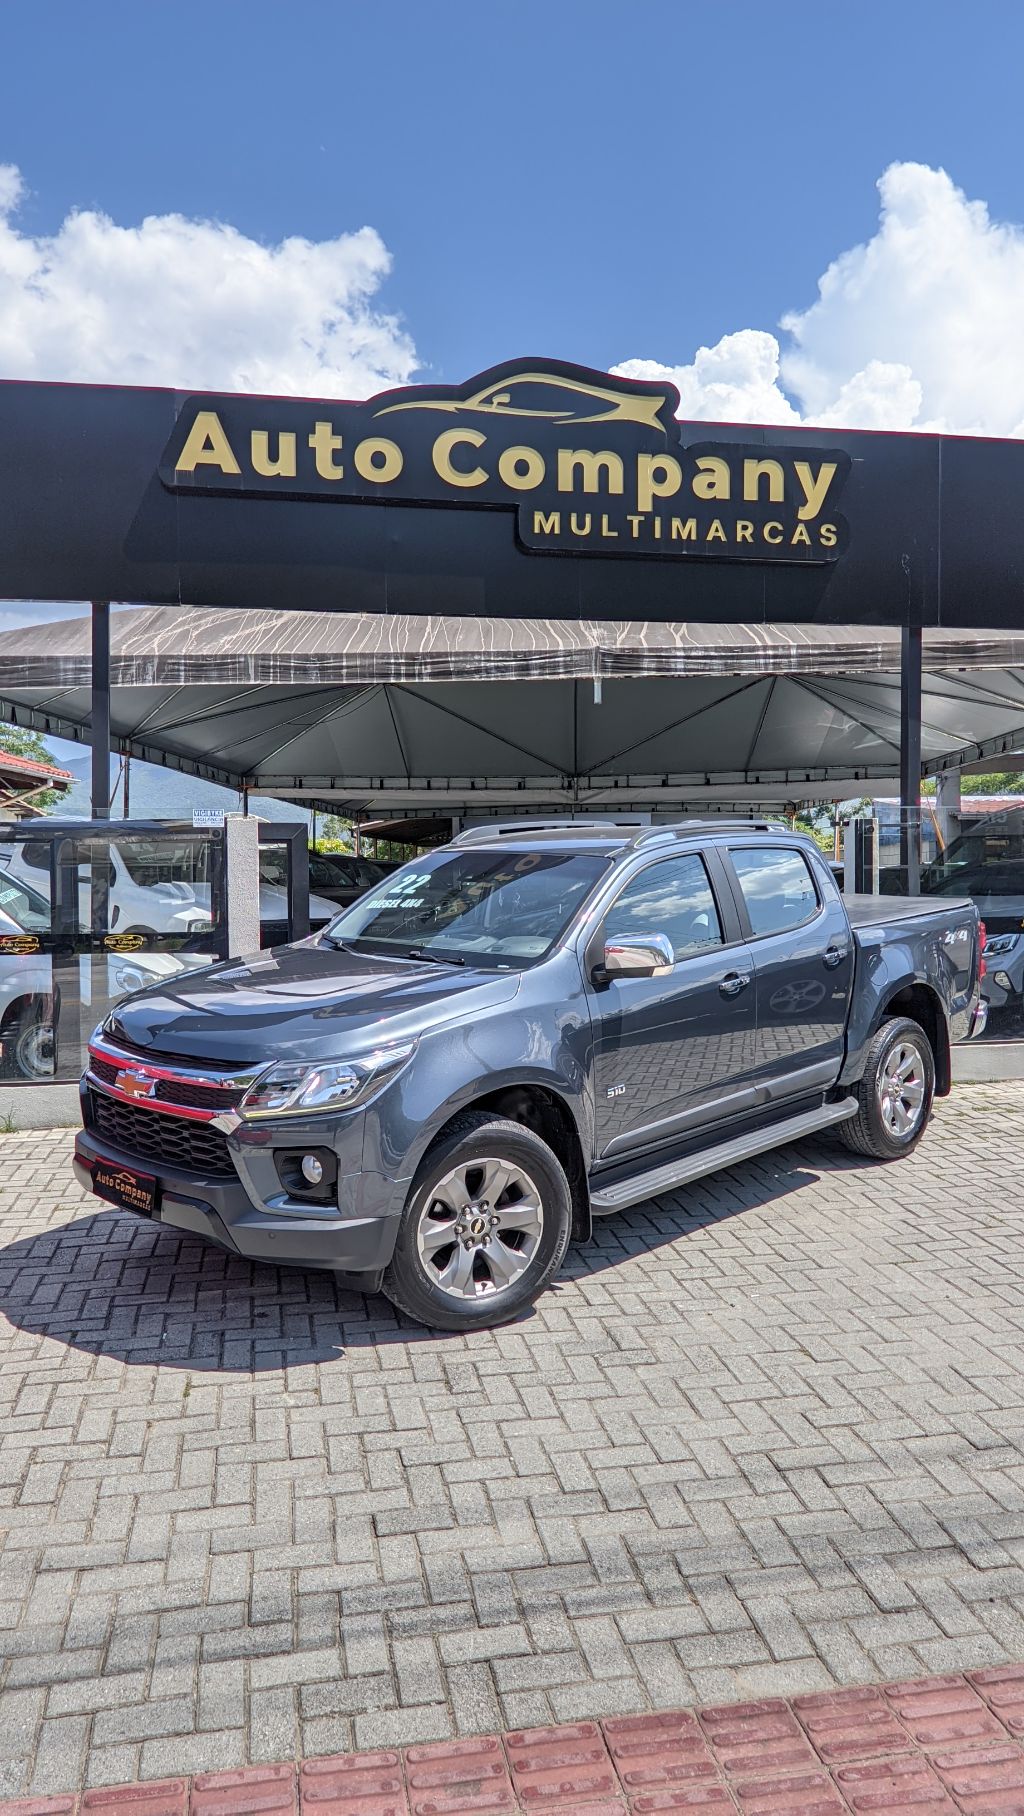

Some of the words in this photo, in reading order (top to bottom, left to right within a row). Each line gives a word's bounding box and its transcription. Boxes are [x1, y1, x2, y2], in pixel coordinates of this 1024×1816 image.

[175, 411, 403, 483] Auto
[432, 428, 837, 520] Company
[534, 511, 837, 546] MULTIMARCAS
[388, 874, 432, 894] 22
[366, 899, 402, 909] DIESEL
[607, 1083, 626, 1099] S10
[96, 1170, 114, 1187] Auto
[115, 1179, 152, 1205] Company
